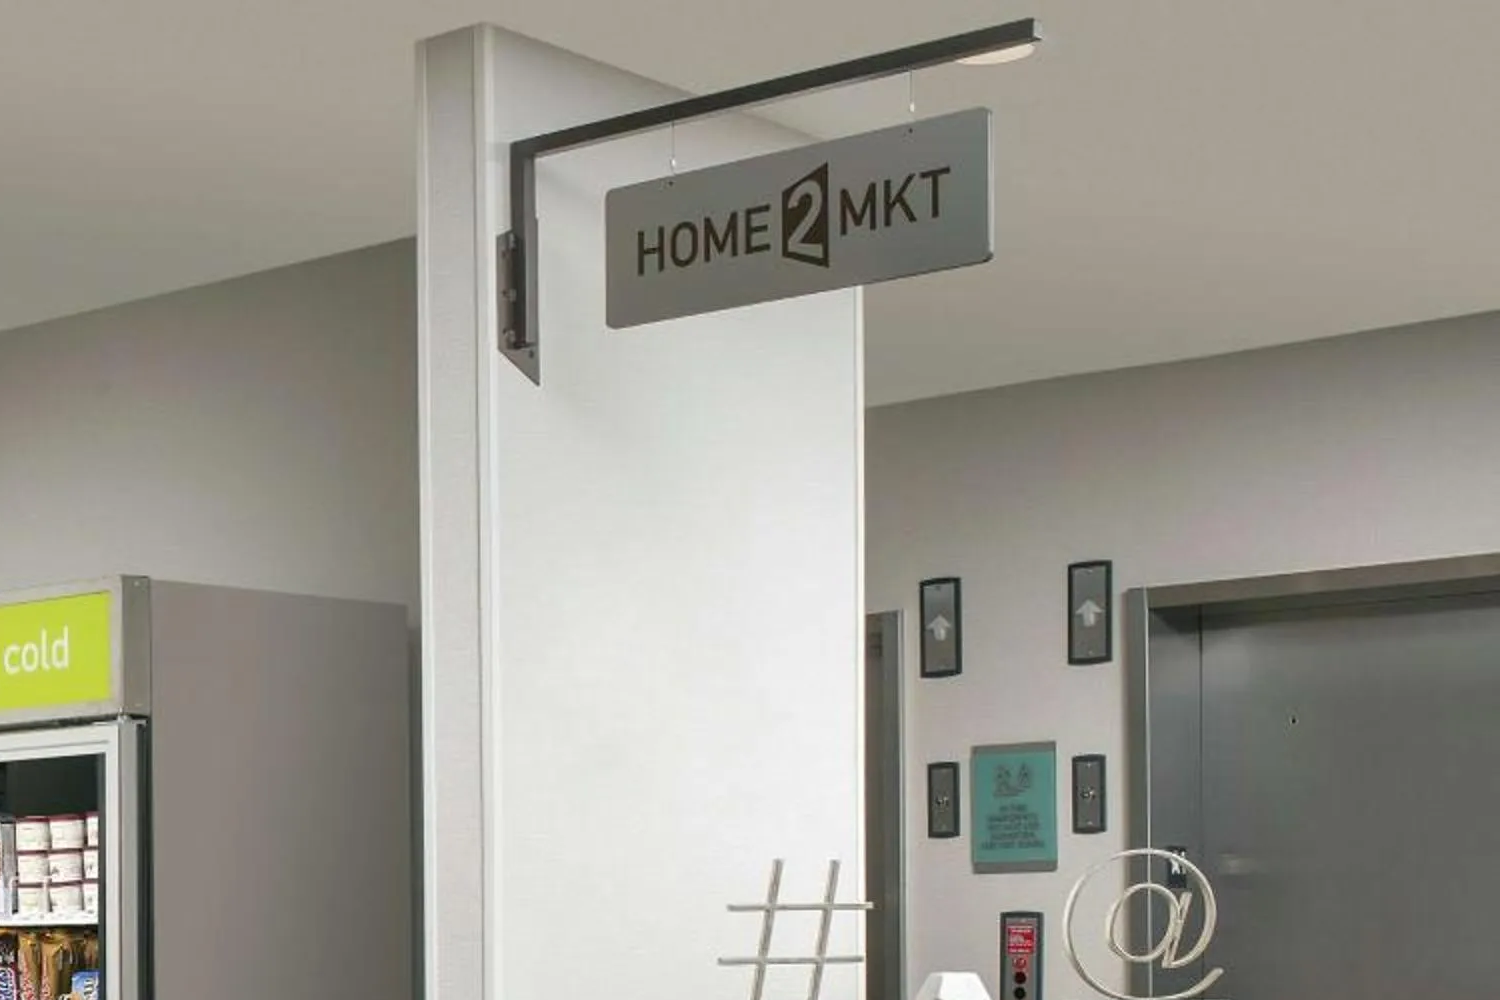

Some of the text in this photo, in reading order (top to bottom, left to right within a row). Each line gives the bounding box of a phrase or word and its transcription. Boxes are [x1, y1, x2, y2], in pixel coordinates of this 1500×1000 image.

[637, 204, 771, 275] HOME
[840, 167, 951, 235] MKT
[3, 626, 69, 674] cold
